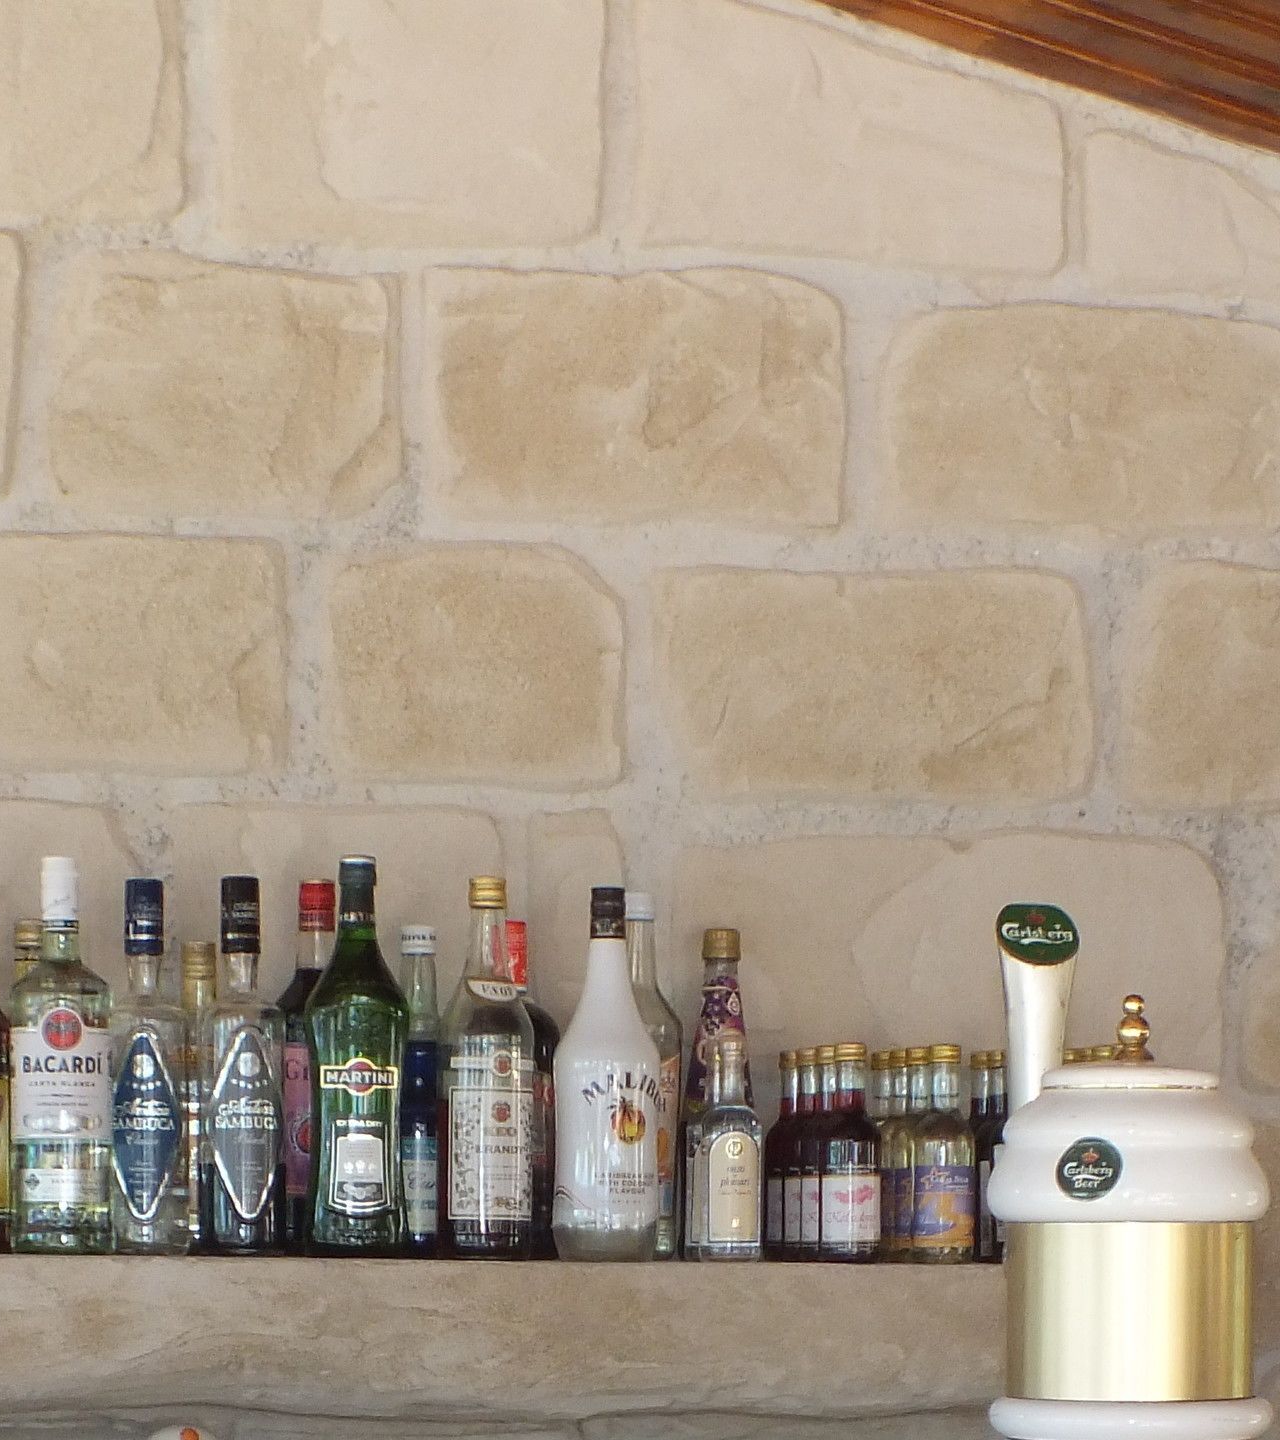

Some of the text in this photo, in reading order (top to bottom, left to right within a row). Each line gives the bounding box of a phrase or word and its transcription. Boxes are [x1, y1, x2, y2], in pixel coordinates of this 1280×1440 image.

[1001, 922, 1074, 944] Carlsberg
[21, 1052, 103, 1074] BACARDÍ
[325, 1070, 394, 1084] MARTINI
[582, 1071, 667, 1113] MALIBU
[112, 1115, 175, 1131] SAMBUCA
[214, 1115, 278, 1130] SAMBUCA
[1062, 1161, 1114, 1179] Carlsberg
